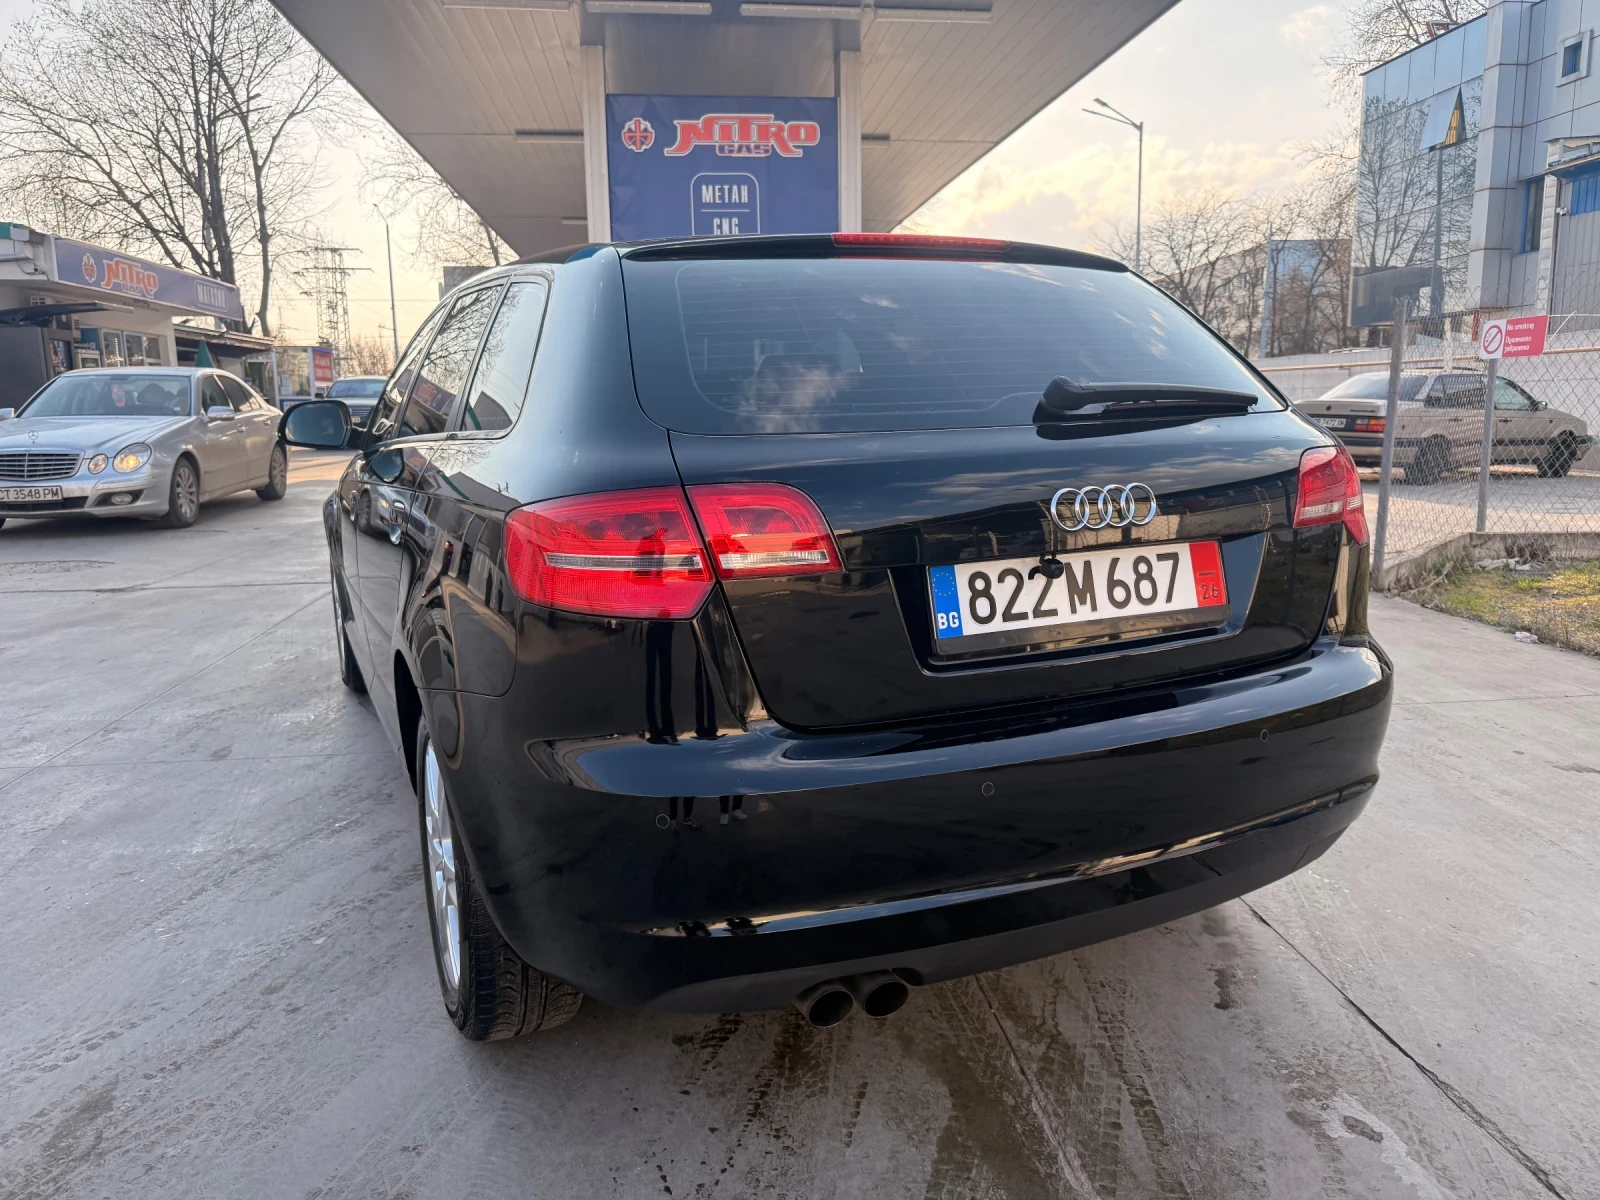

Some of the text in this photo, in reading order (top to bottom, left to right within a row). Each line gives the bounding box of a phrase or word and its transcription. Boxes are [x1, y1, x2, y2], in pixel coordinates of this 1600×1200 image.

[715, 142, 773, 158] GAS
[701, 184, 749, 203] МЕТАН
[713, 217, 740, 235] CNG
[1507, 322, 1535, 331] No smoking
[13, 488, 41, 500] 3548
[43, 487, 59, 499] PM
[1106, 551, 1180, 610] 687
[1200, 582, 1219, 600] 26
[937, 612, 960, 630] BG
